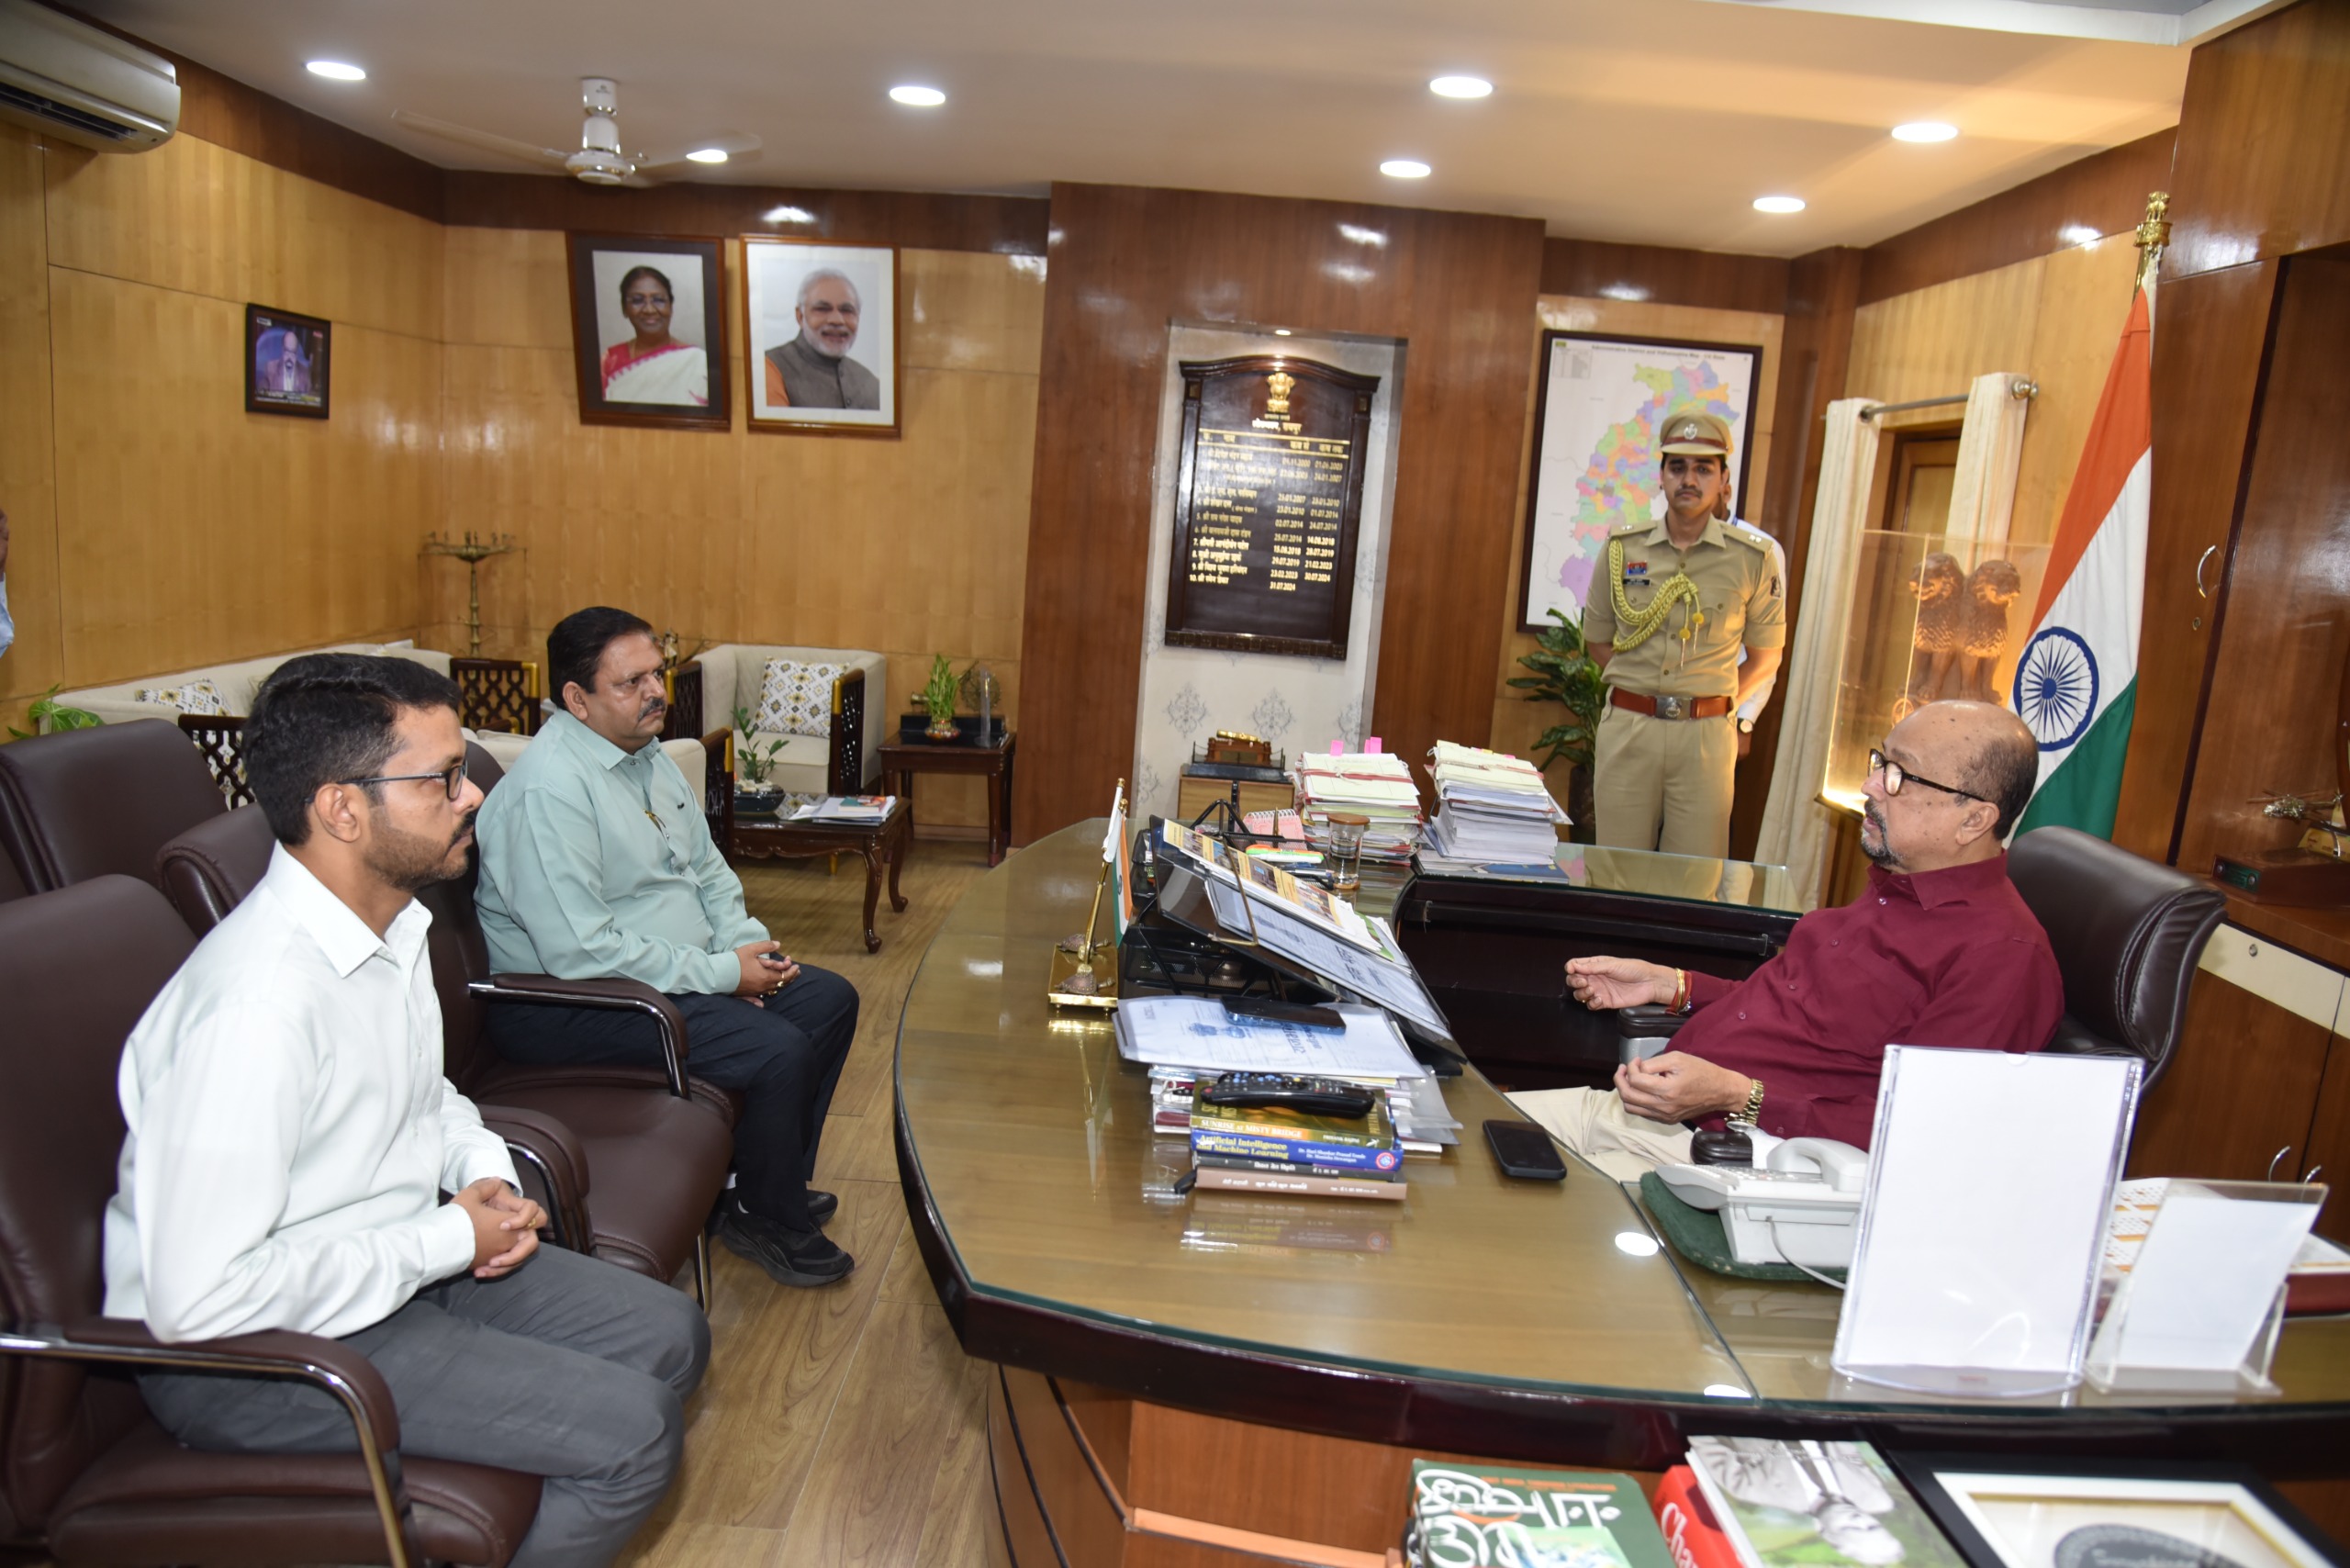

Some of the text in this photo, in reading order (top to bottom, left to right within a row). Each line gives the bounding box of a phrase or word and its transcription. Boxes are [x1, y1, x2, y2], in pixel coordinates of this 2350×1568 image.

[1201, 1119, 1235, 1130] SUNRISE
[1246, 1124, 1270, 1135] MISTY
[1270, 1127, 1302, 1137] BRIDGE
[1200, 1135, 1287, 1150] Artificial Intelligence
[1214, 1145, 1249, 1155] Machine
[1250, 1148, 1289, 1160] Learning
